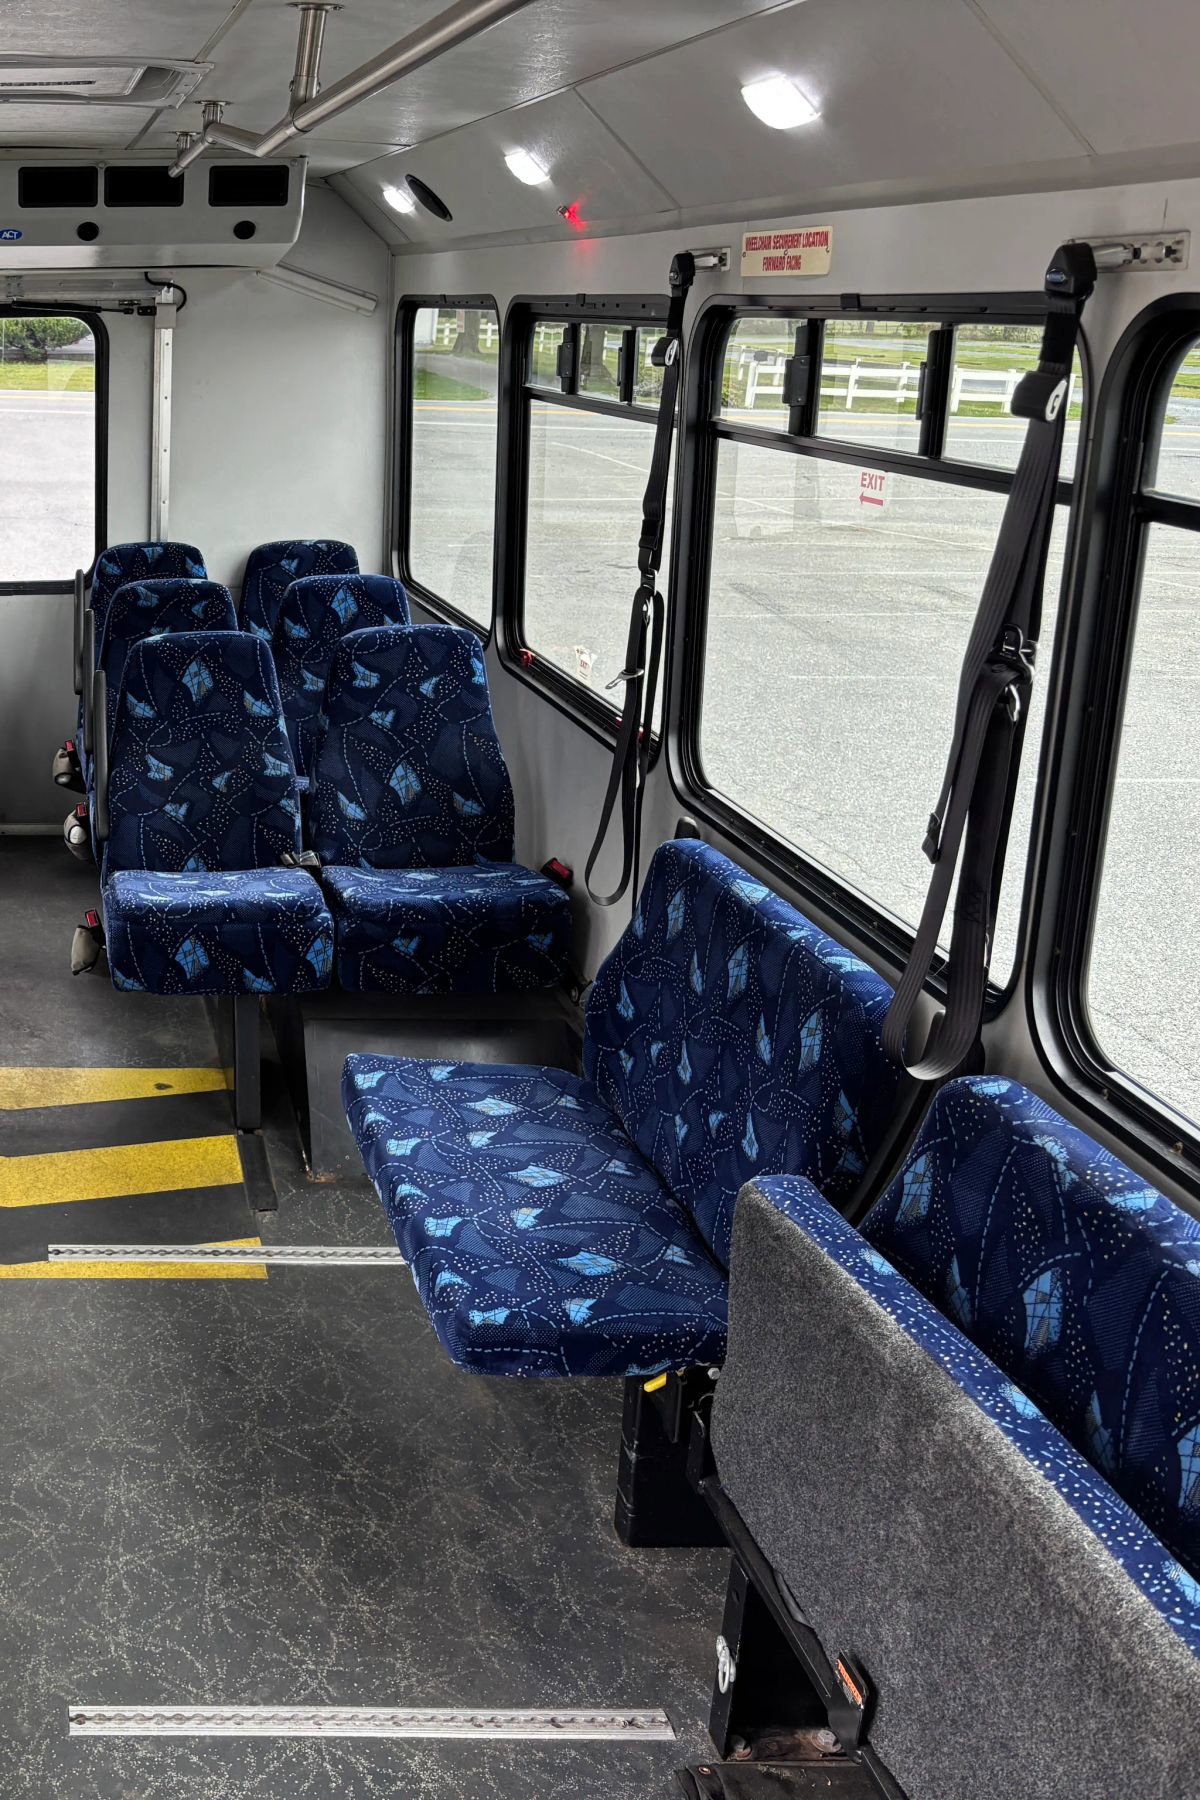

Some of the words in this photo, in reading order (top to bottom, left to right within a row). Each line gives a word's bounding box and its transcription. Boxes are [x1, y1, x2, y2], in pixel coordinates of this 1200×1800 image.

[1, 230, 19, 239] ACT
[745, 235, 772, 251] WHEELCHAIR
[772, 233, 802, 250] SECUREMENT
[802, 231, 829, 248] LOCATION
[762, 256, 786, 272] FORWARD
[786, 255, 801, 271] FACING
[860, 471, 885, 491] EXIT
